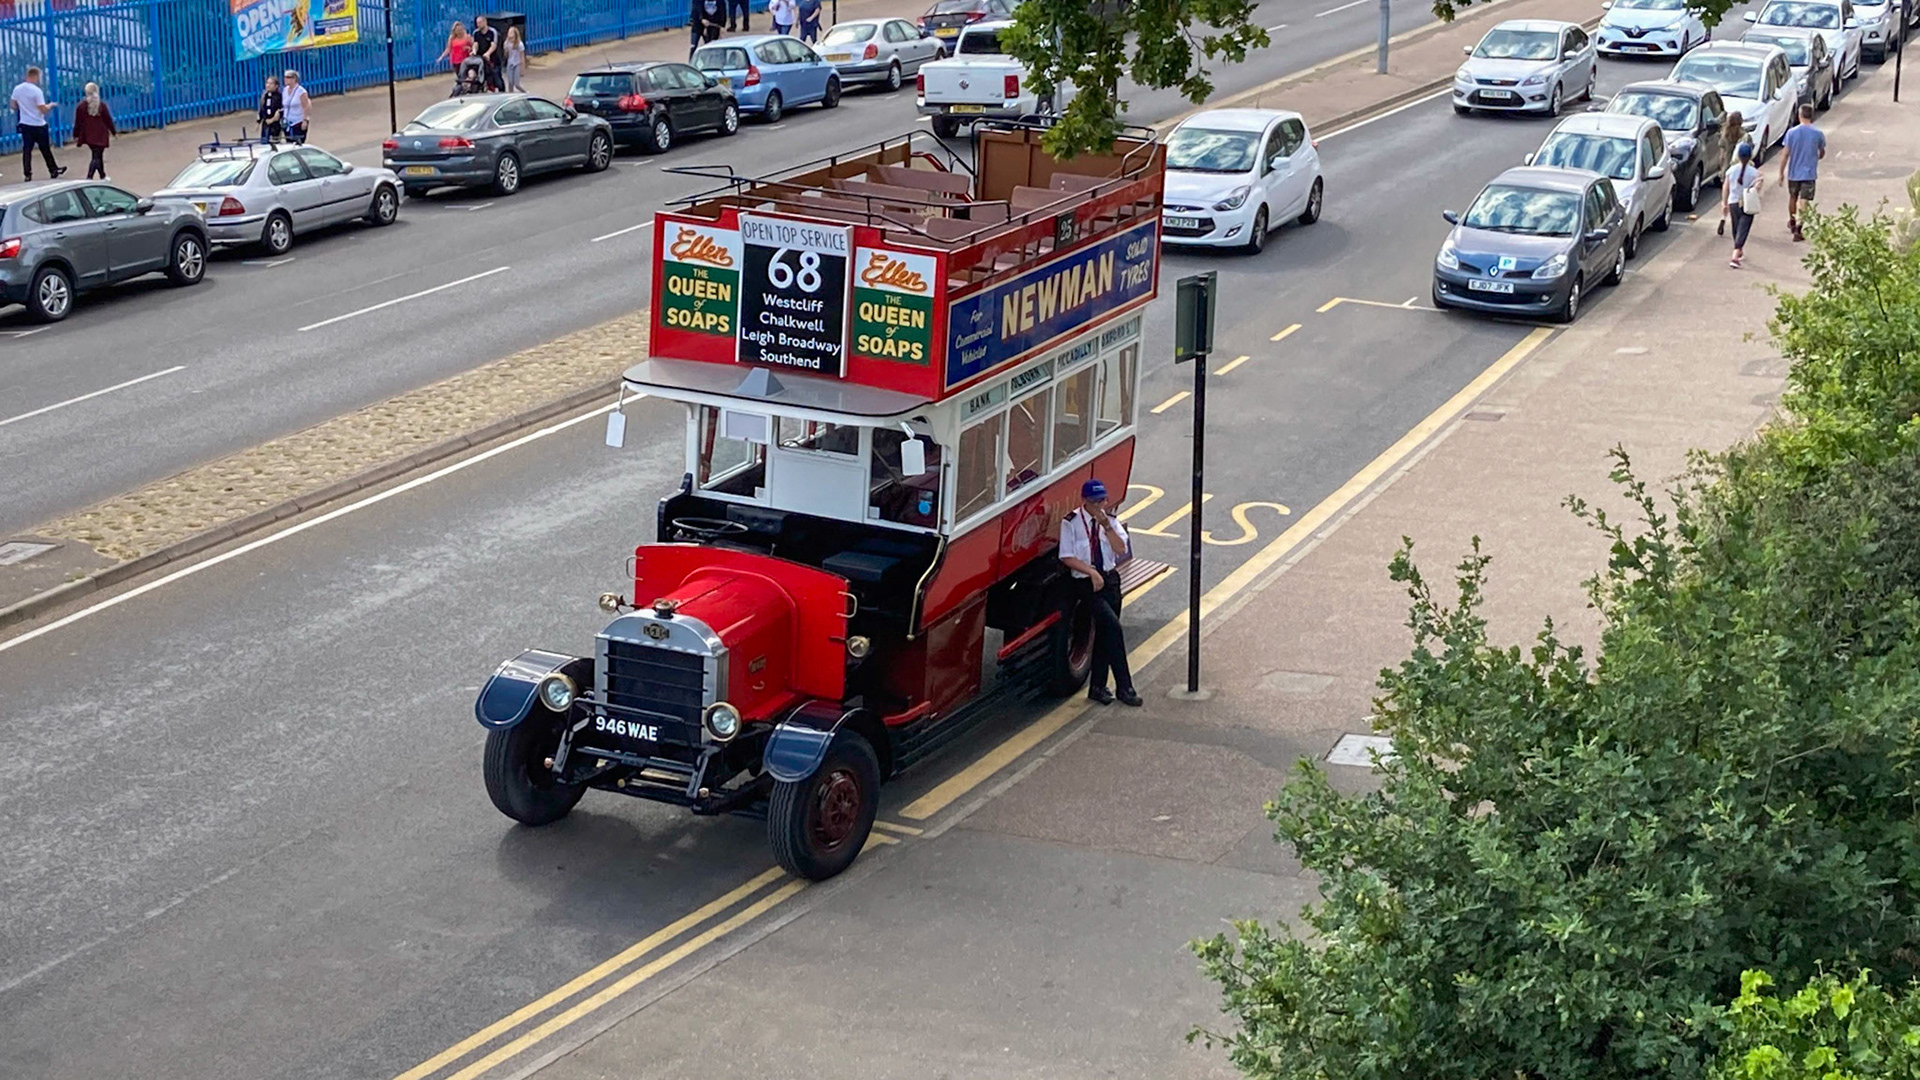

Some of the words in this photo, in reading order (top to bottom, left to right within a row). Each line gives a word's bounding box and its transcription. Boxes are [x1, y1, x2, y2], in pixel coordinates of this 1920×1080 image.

[237, 0, 281, 37] OPEN
[743, 221, 773, 241] OPEN
[776, 225, 797, 244] TOP
[800, 228, 846, 251] SERVICE
[1060, 218, 1073, 241] 25
[670, 226, 734, 267] Ellen
[693, 268, 709, 279] THE
[768, 248, 822, 293] 68
[861, 251, 928, 292] Ellen
[1120, 259, 1150, 292] TYRES
[668, 275, 731, 302] QUEEN
[885, 294, 902, 305] THE
[1001, 250, 1115, 340] NEWMAN
[1494, 282, 1510, 292] JFK
[693, 299, 707, 310] of
[762, 293, 824, 313] Westcliff
[859, 302, 925, 329] QUEEN
[667, 307, 730, 333] SOAPS
[759, 311, 825, 333] Chalkwell
[885, 326, 899, 338] of
[742, 327, 775, 346] Leigh
[778, 332, 841, 356] Broadway
[857, 335, 923, 360] SOAPS
[955, 321, 994, 349] Commercial
[759, 348, 821, 369] Southend
[969, 391, 991, 413] BANK
